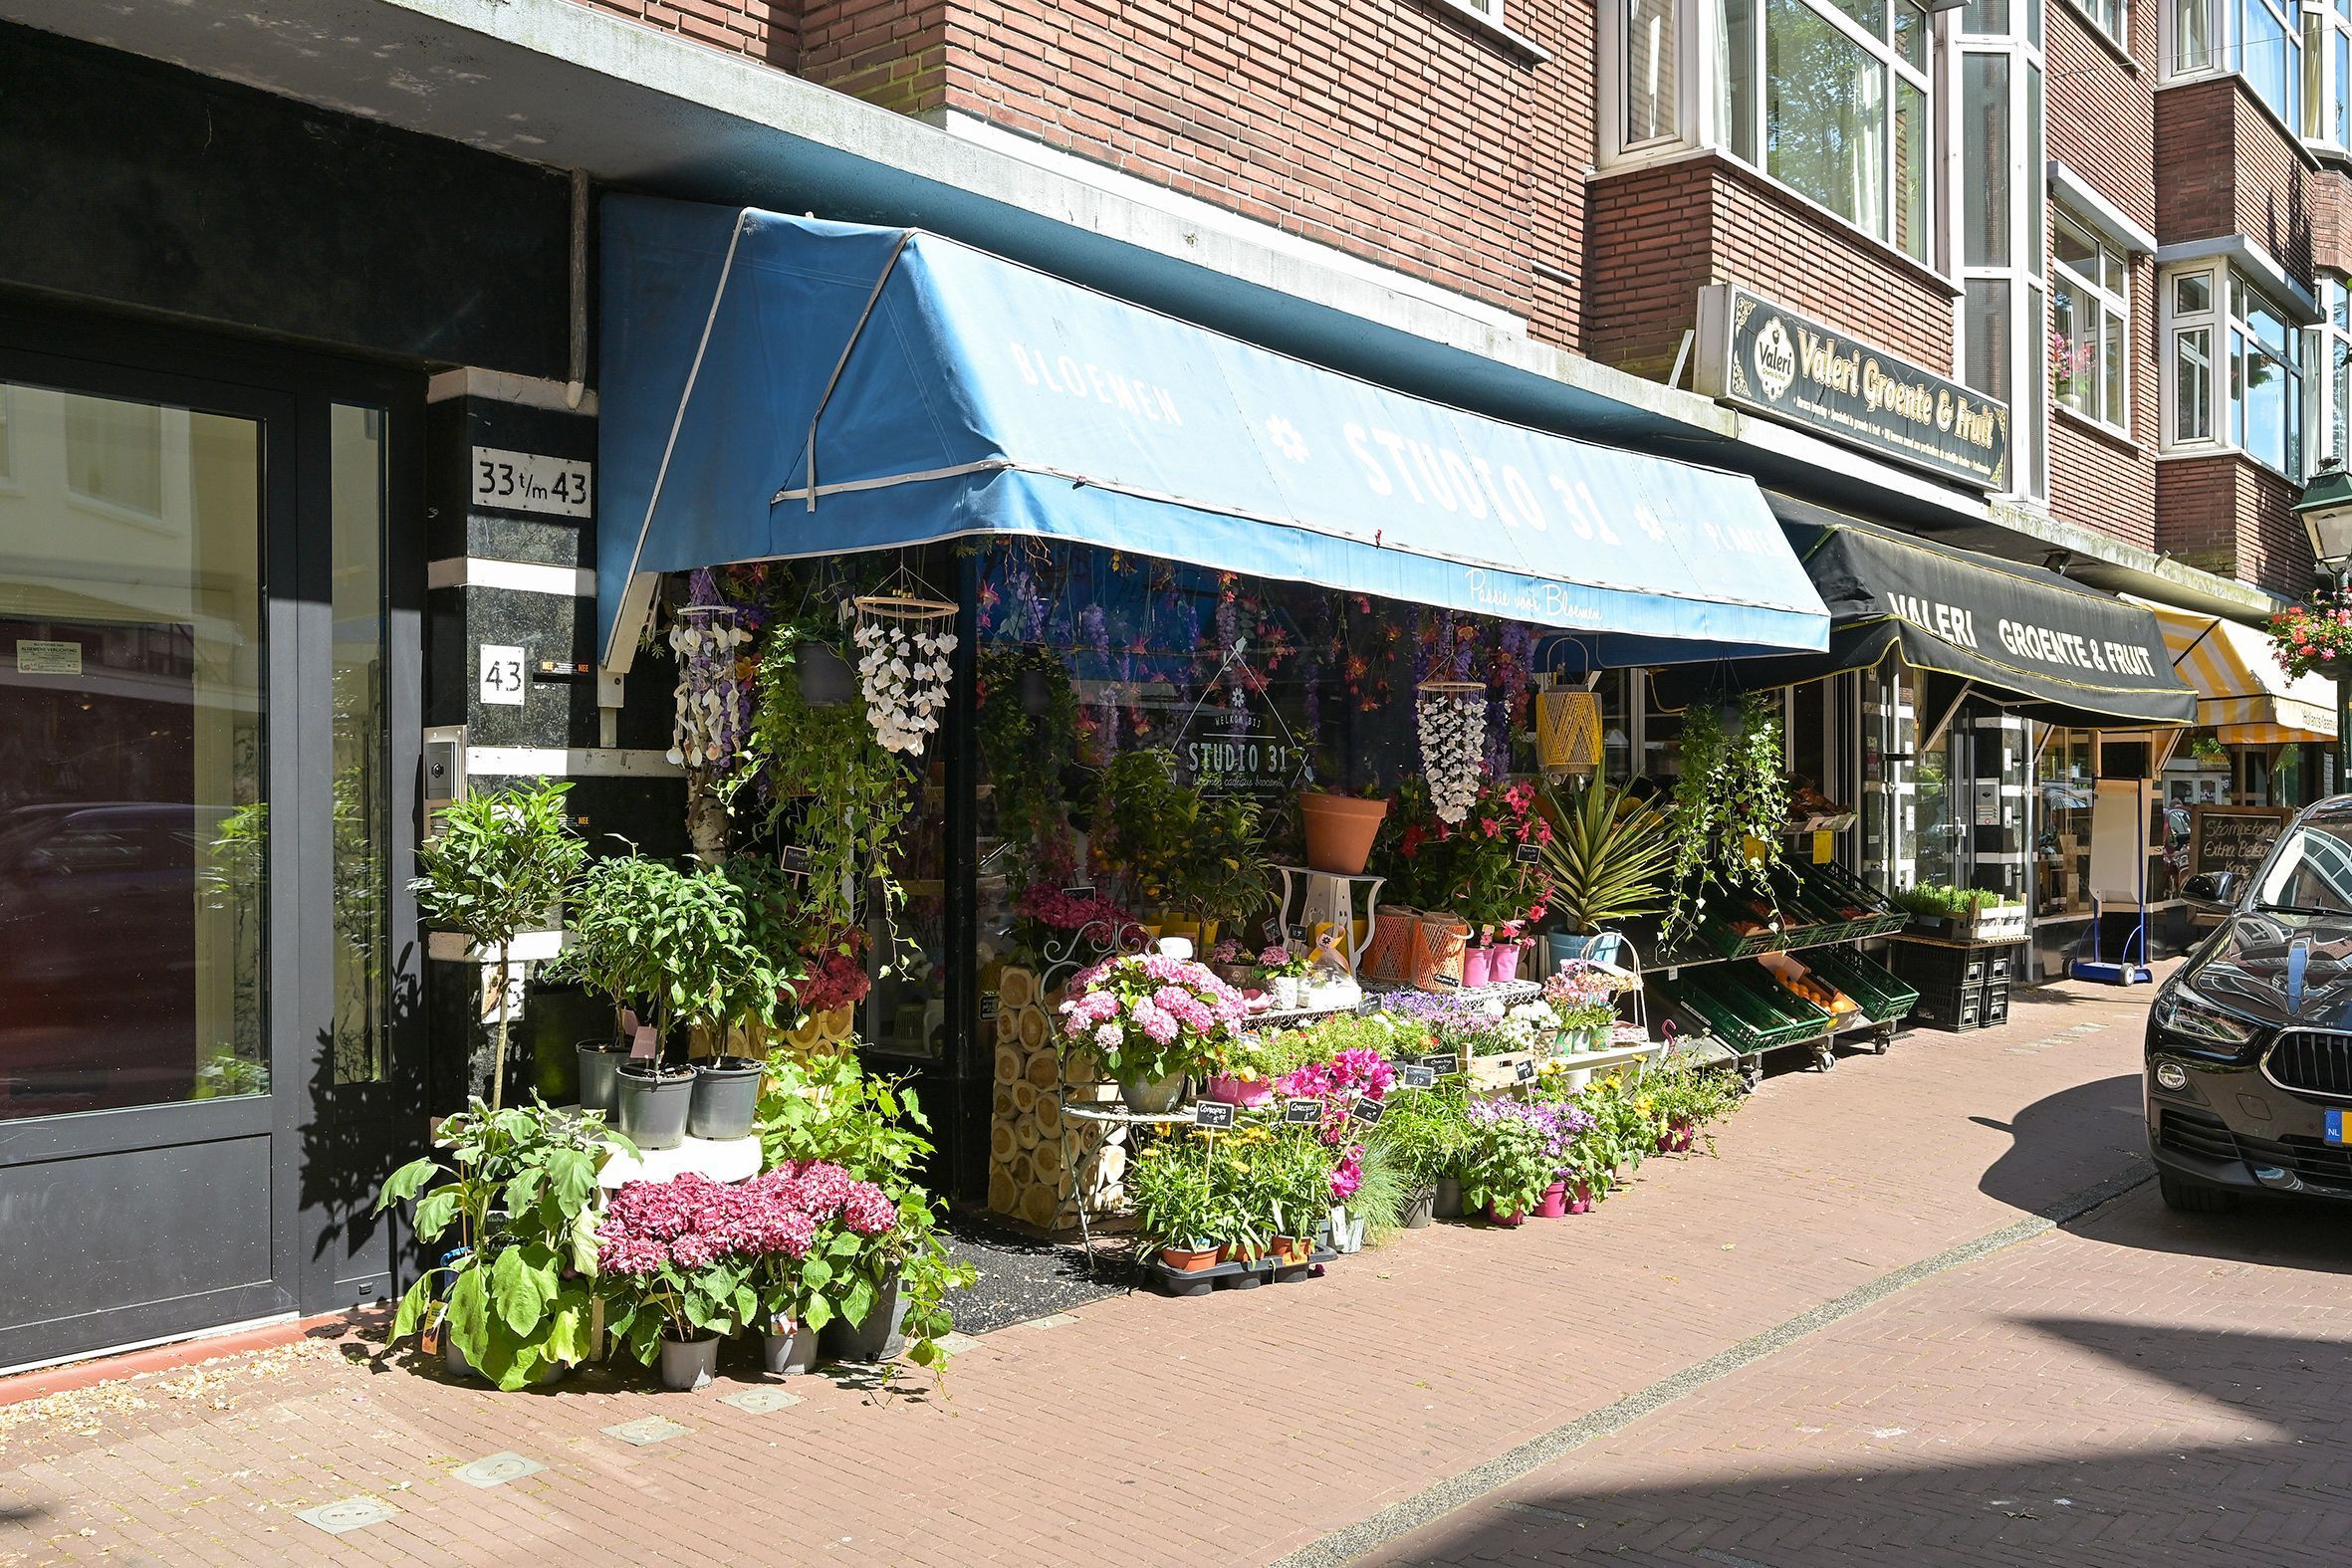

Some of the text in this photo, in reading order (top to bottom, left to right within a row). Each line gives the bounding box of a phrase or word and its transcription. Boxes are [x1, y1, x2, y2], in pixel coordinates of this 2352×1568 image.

[1759, 341, 1791, 375] Valeri
[1009, 341, 1184, 427] BLOEMEN
[1796, 327, 1861, 398] Valeri
[1862, 357, 1933, 426] Groente
[1936, 388, 1954, 433] &
[1954, 395, 1995, 450] Fruit
[479, 460, 588, 505] 33 t/m 43
[1342, 421, 1622, 547] STUDIO 31
[1465, 568, 1603, 621] Passie voor Bloemen
[1887, 591, 2156, 678] VALERI GROENTE & FRUIT
[485, 660, 522, 692] 43
[542, 661, 555, 671] NEE
[578, 663, 589, 673] NEE
[1215, 714, 1262, 729] WELKOM BIJ
[1188, 742, 1288, 774] STUDIO 31
[2327, 1128, 2340, 1137] NL
